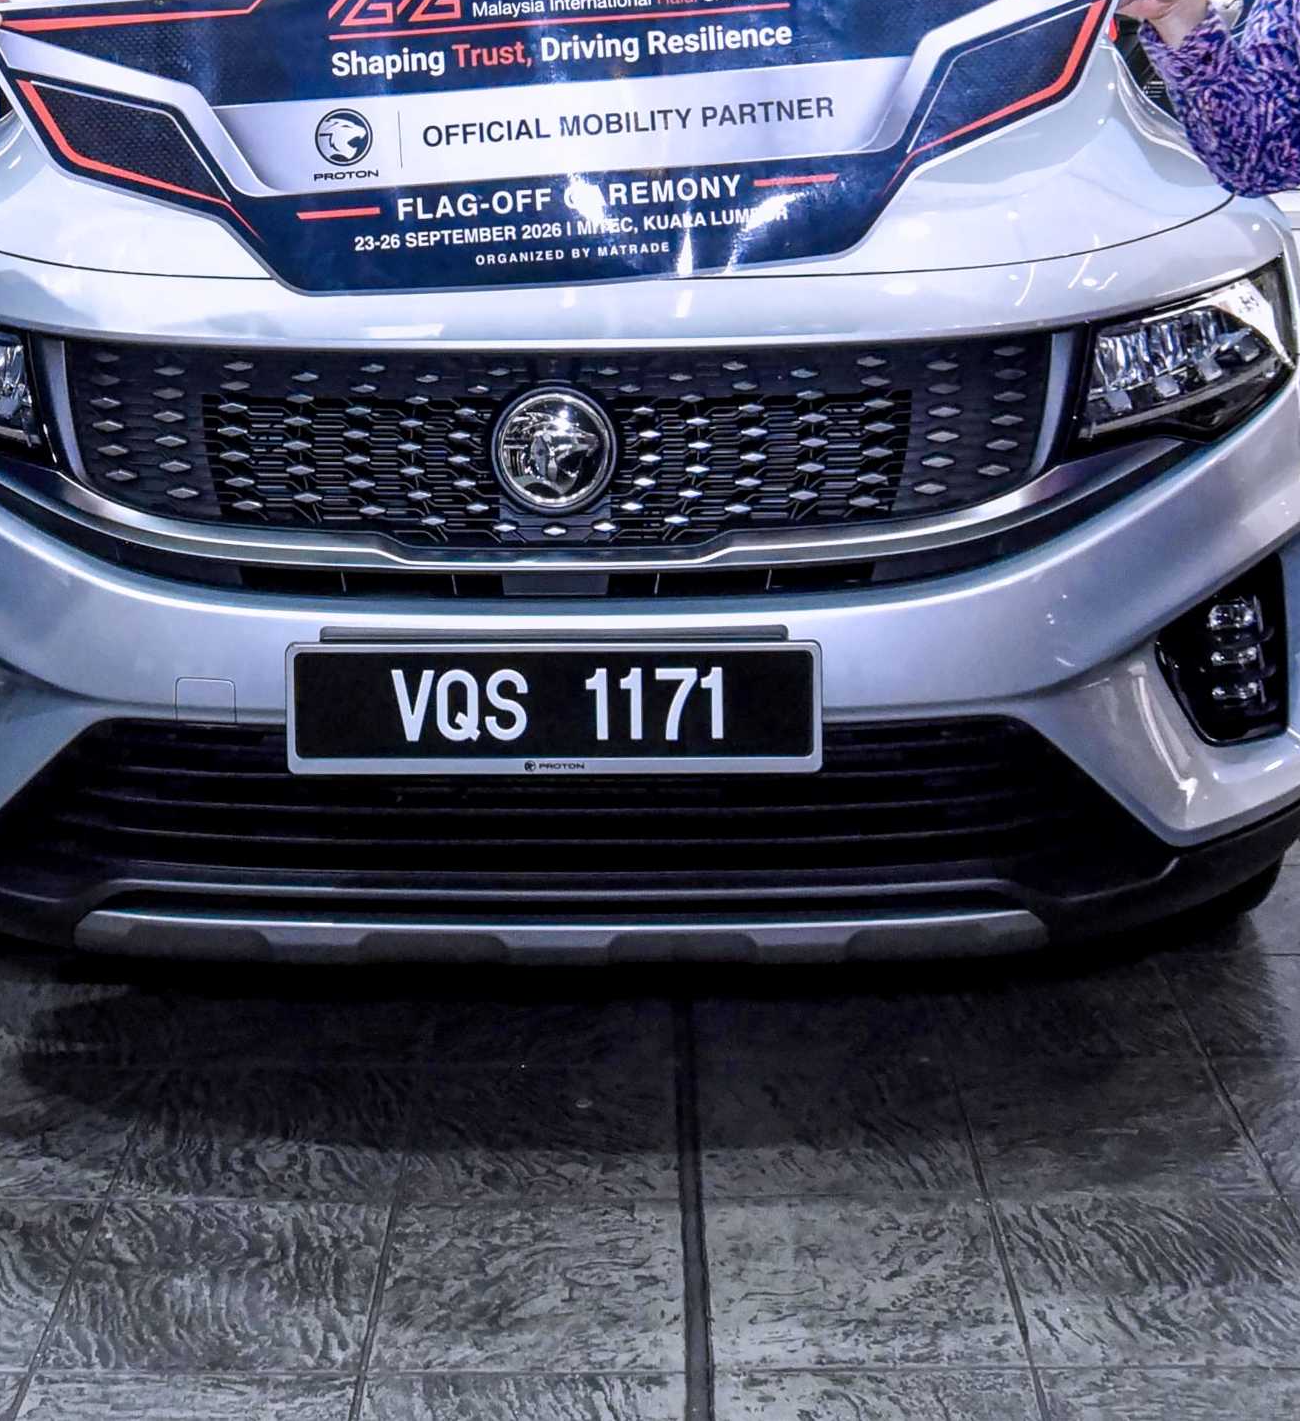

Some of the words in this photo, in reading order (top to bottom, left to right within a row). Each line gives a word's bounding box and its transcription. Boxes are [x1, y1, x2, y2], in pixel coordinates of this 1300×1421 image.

[331, 48, 445, 80] Shaping
[452, 41, 533, 69] Trust,
[541, 35, 640, 66] Driving
[647, 26, 793, 56] Resilience
[422, 119, 551, 148] OFFICIAL
[559, 108, 692, 138] MOBILITY
[702, 97, 834, 128] PARTNER
[314, 170, 379, 181] PROTON
[397, 188, 552, 221] FLAG-OFF
[564, 174, 741, 210] CREMONY
[354, 234, 400, 251] 23-26
[404, 225, 517, 249] SEPTEMBER
[521, 222, 562, 239] 2026
[711, 206, 789, 227] LUMR
[475, 250, 569, 265] ORGANIZED
[572, 248, 591, 259] BY
[597, 241, 670, 257] MATRADE
[391, 669, 528, 742] VQS
[585, 667, 724, 740] 1171
[538, 762, 585, 770] PROTON
